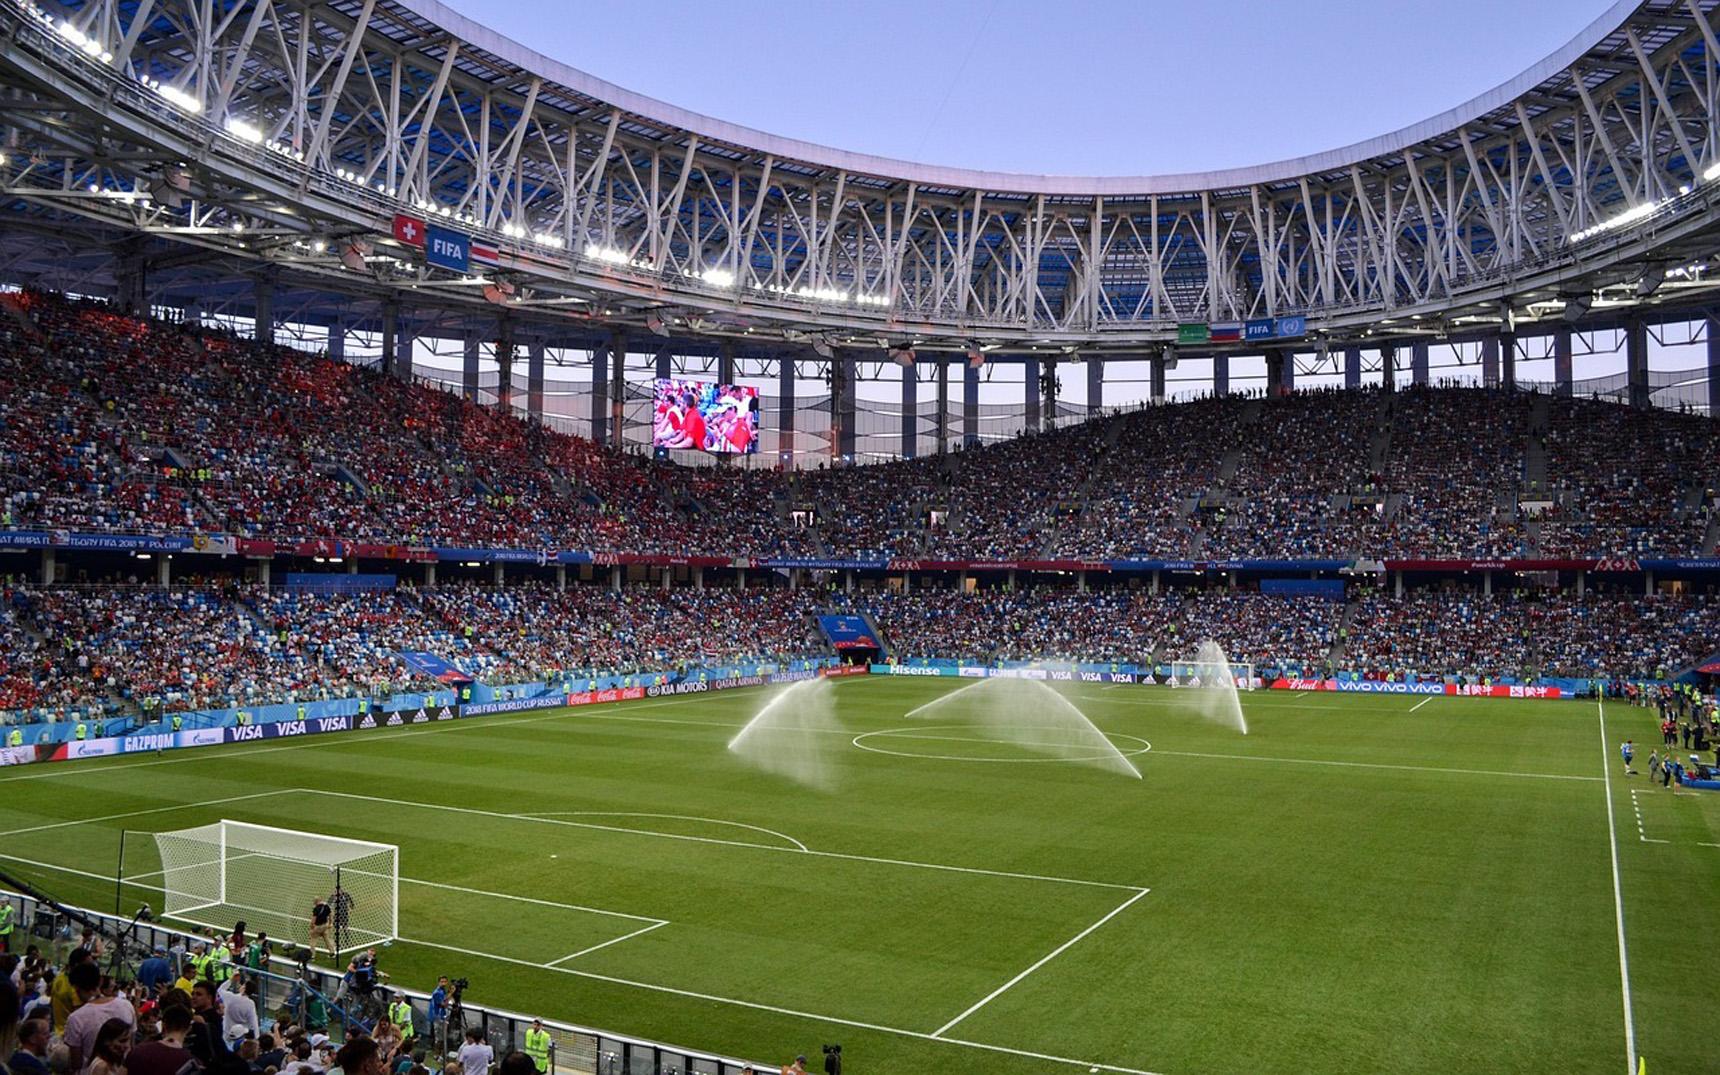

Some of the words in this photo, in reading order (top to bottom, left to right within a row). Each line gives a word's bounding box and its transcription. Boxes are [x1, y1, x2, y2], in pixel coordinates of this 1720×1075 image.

[433, 239, 462, 260] FIFA
[1249, 326, 1268, 335] FIFA
[118, 539, 137, 549] 2018
[890, 664, 941, 675] Hisense
[1051, 671, 1072, 680] VISA
[716, 679, 736, 689] QATAR
[737, 676, 762, 687] AIRWAYS
[1080, 672, 1102, 682] VISA
[1110, 673, 1132, 683] VISA
[661, 684, 675, 695] KIA
[676, 681, 707, 693] MOTORS
[1288, 679, 1318, 690] Bud
[466, 704, 481, 715] 2018
[483, 702, 497, 713] FIFA
[499, 701, 522, 712] WORLD
[523, 700, 536, 709] CUP
[275, 720, 306, 736] VISA
[317, 716, 347, 731] VISA
[231, 725, 263, 741] VISA
[125, 733, 173, 752] GAZPROM
